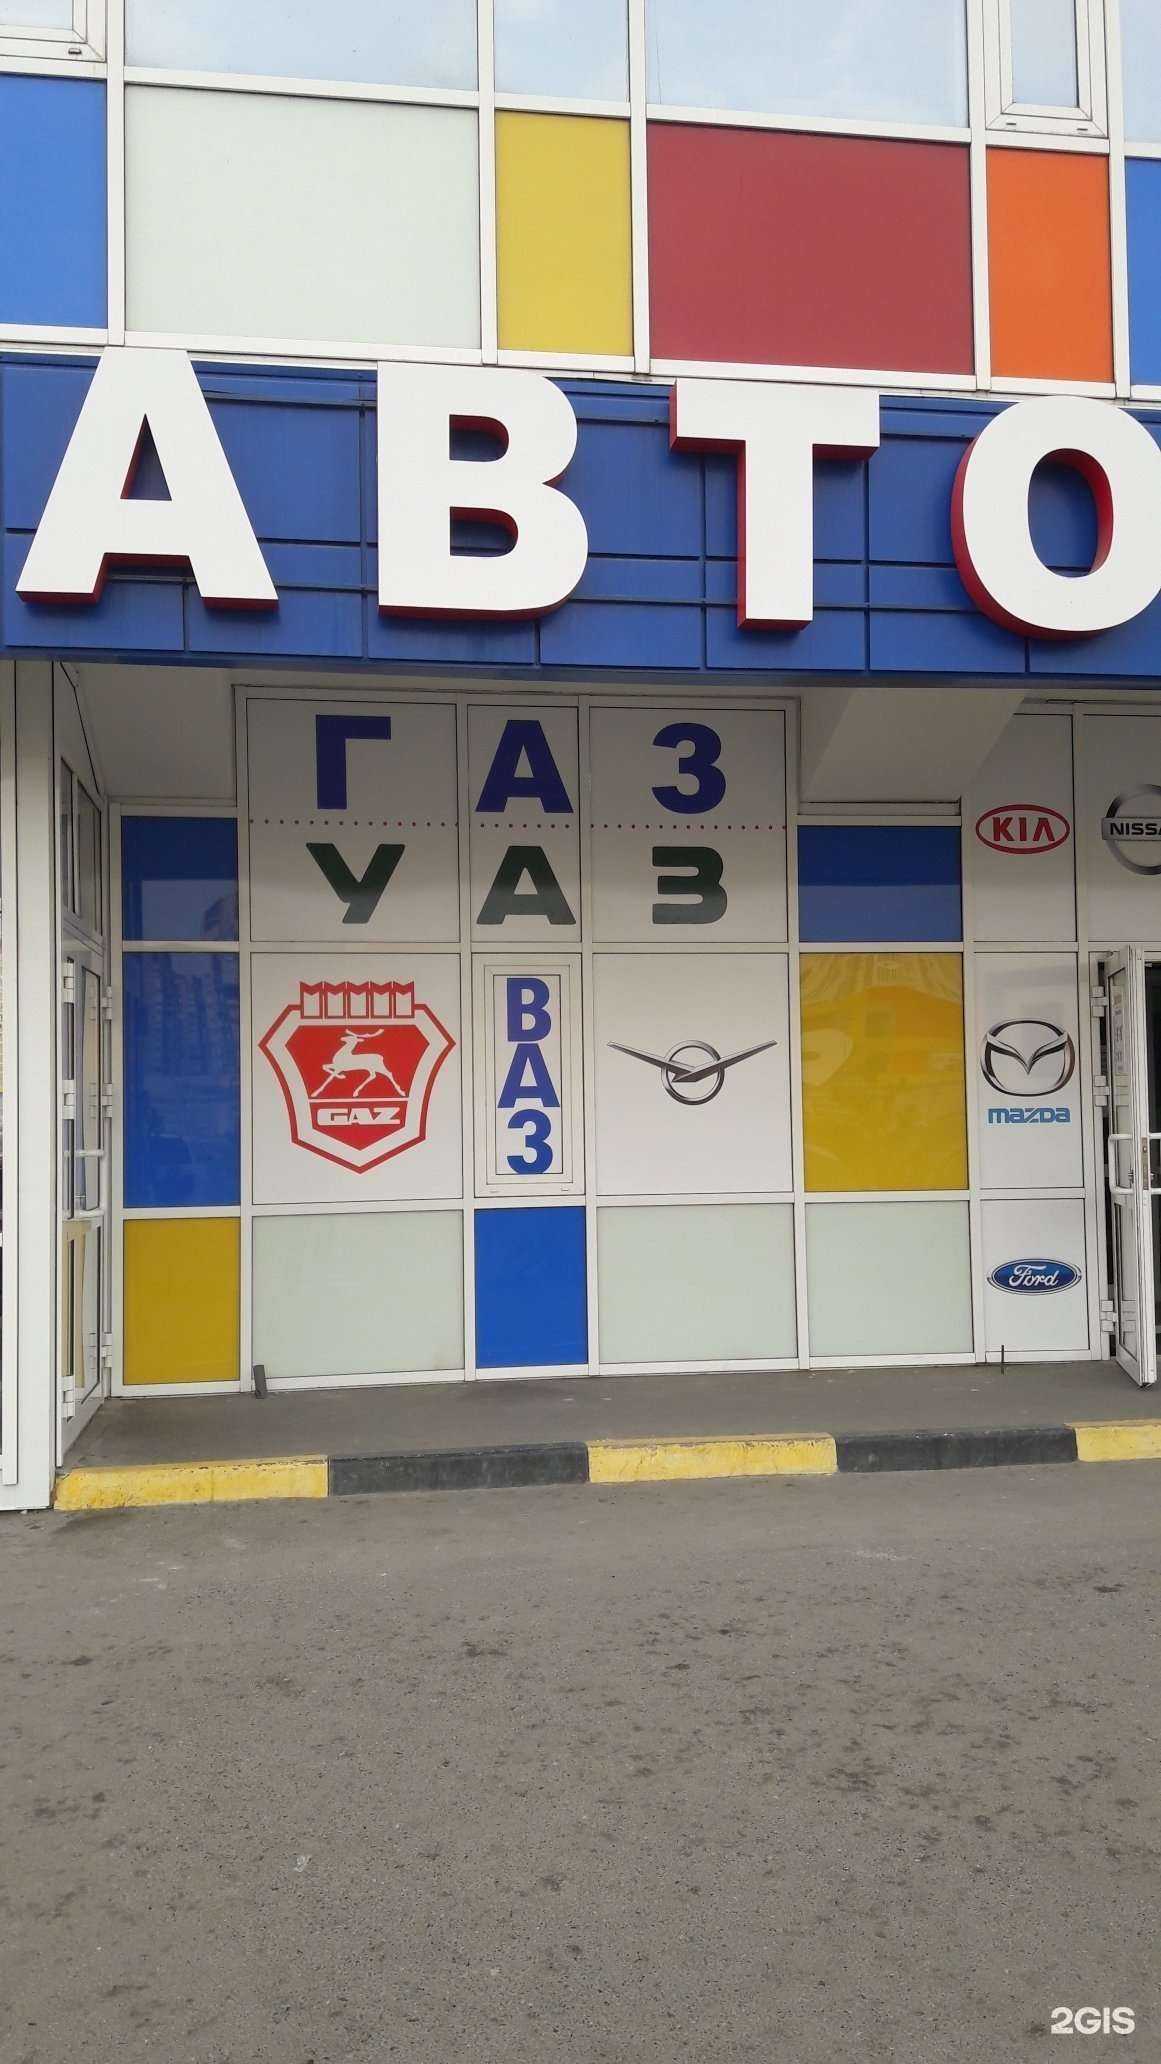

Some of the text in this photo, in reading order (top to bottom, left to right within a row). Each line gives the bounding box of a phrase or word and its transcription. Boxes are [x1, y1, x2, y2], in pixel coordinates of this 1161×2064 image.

[16, 347, 1161, 638] АВТО
[315, 714, 727, 814] ГАЗ
[992, 816, 1056, 842] KIA
[1110, 822, 1161, 836] NISS
[305, 842, 728, 925] УАЗ
[497, 976, 561, 1176] ВАЗ
[316, 1106, 401, 1127] GAZ
[1008, 1264, 1061, 1288] Ford
